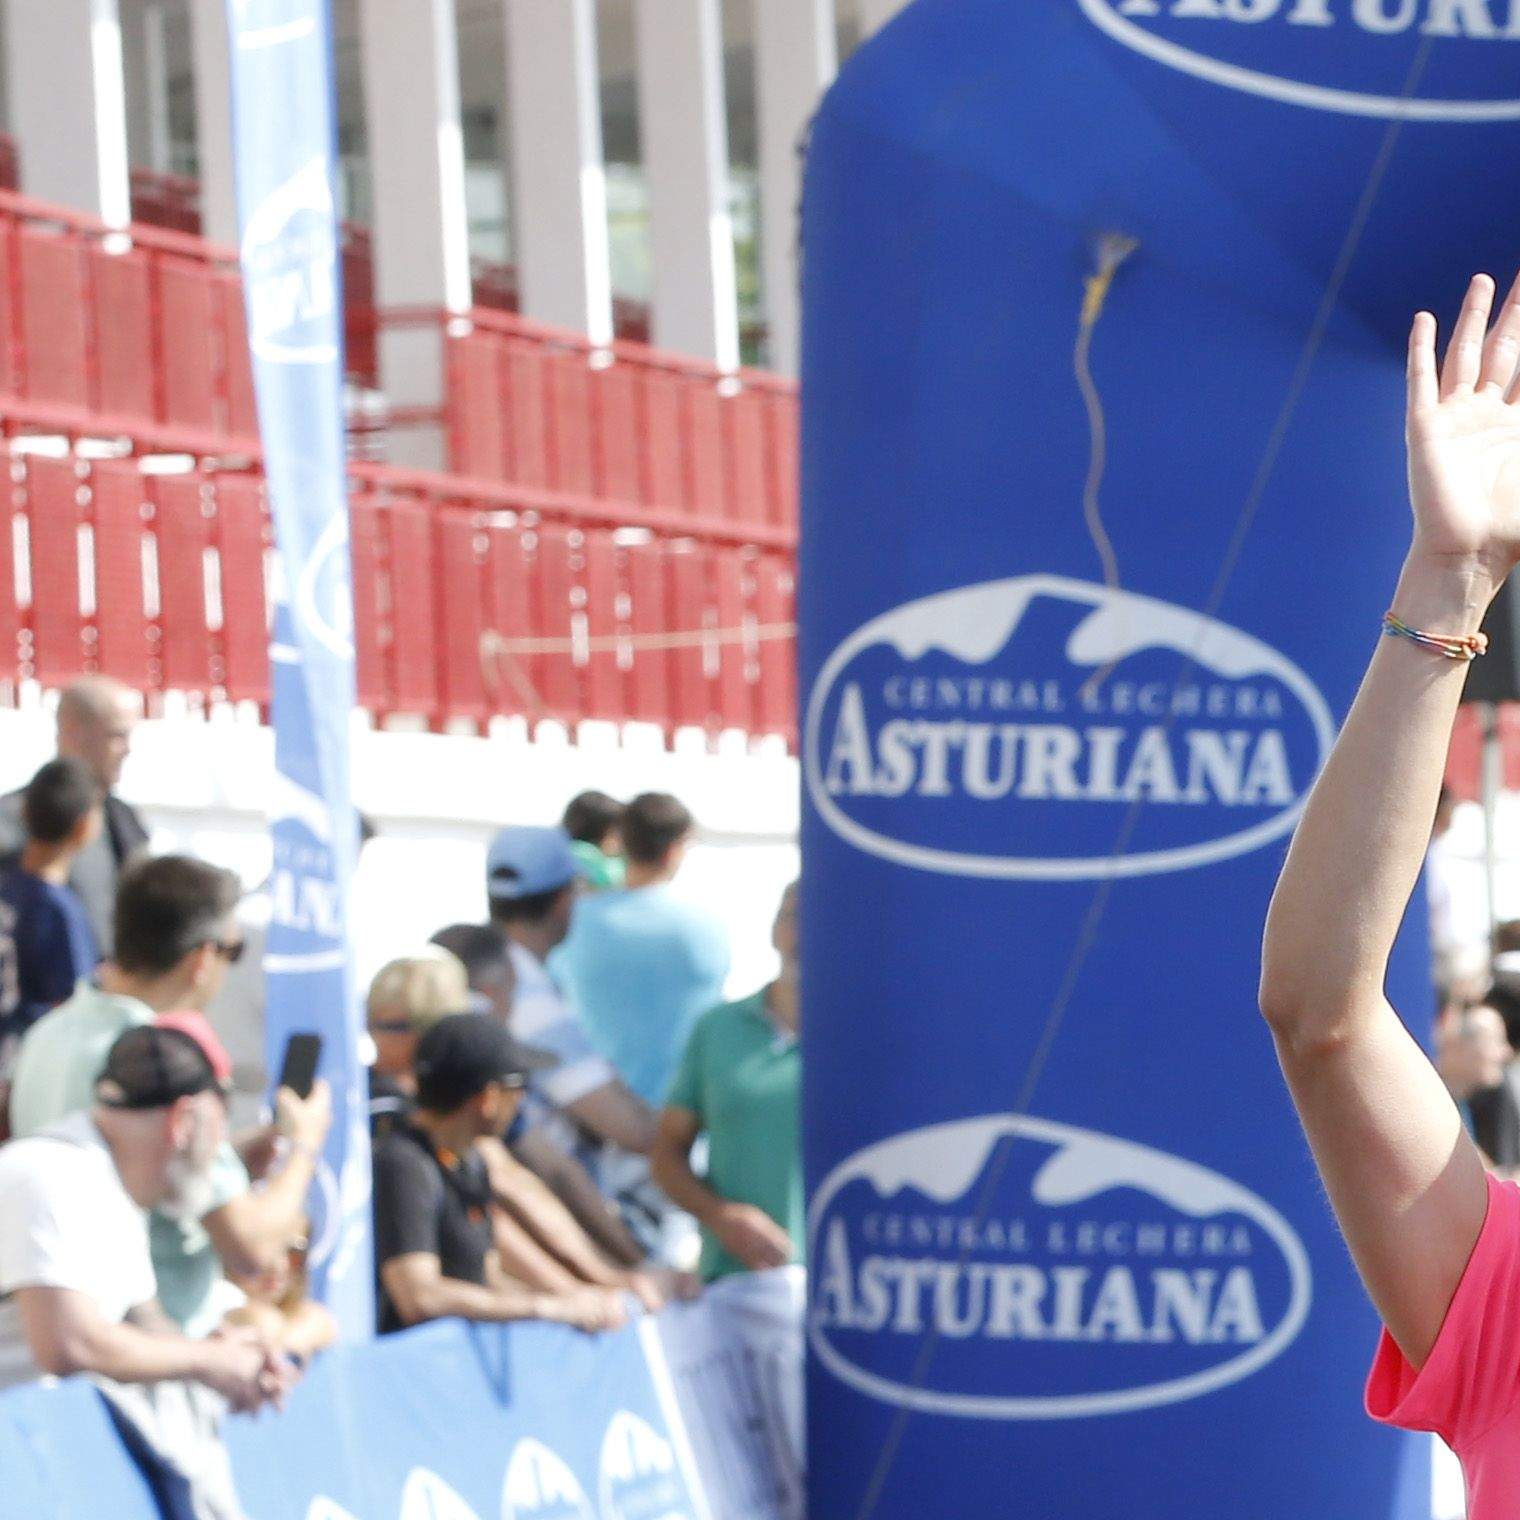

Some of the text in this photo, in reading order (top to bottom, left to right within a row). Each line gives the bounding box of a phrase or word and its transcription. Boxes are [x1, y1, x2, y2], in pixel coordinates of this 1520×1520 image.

[883, 674, 1064, 711] CENTRAL
[826, 684, 1297, 806] ASTURIANA
[863, 1214, 1251, 1258] CENTRAL LECHERA
[812, 1218, 1266, 1345] ASTURIANA
